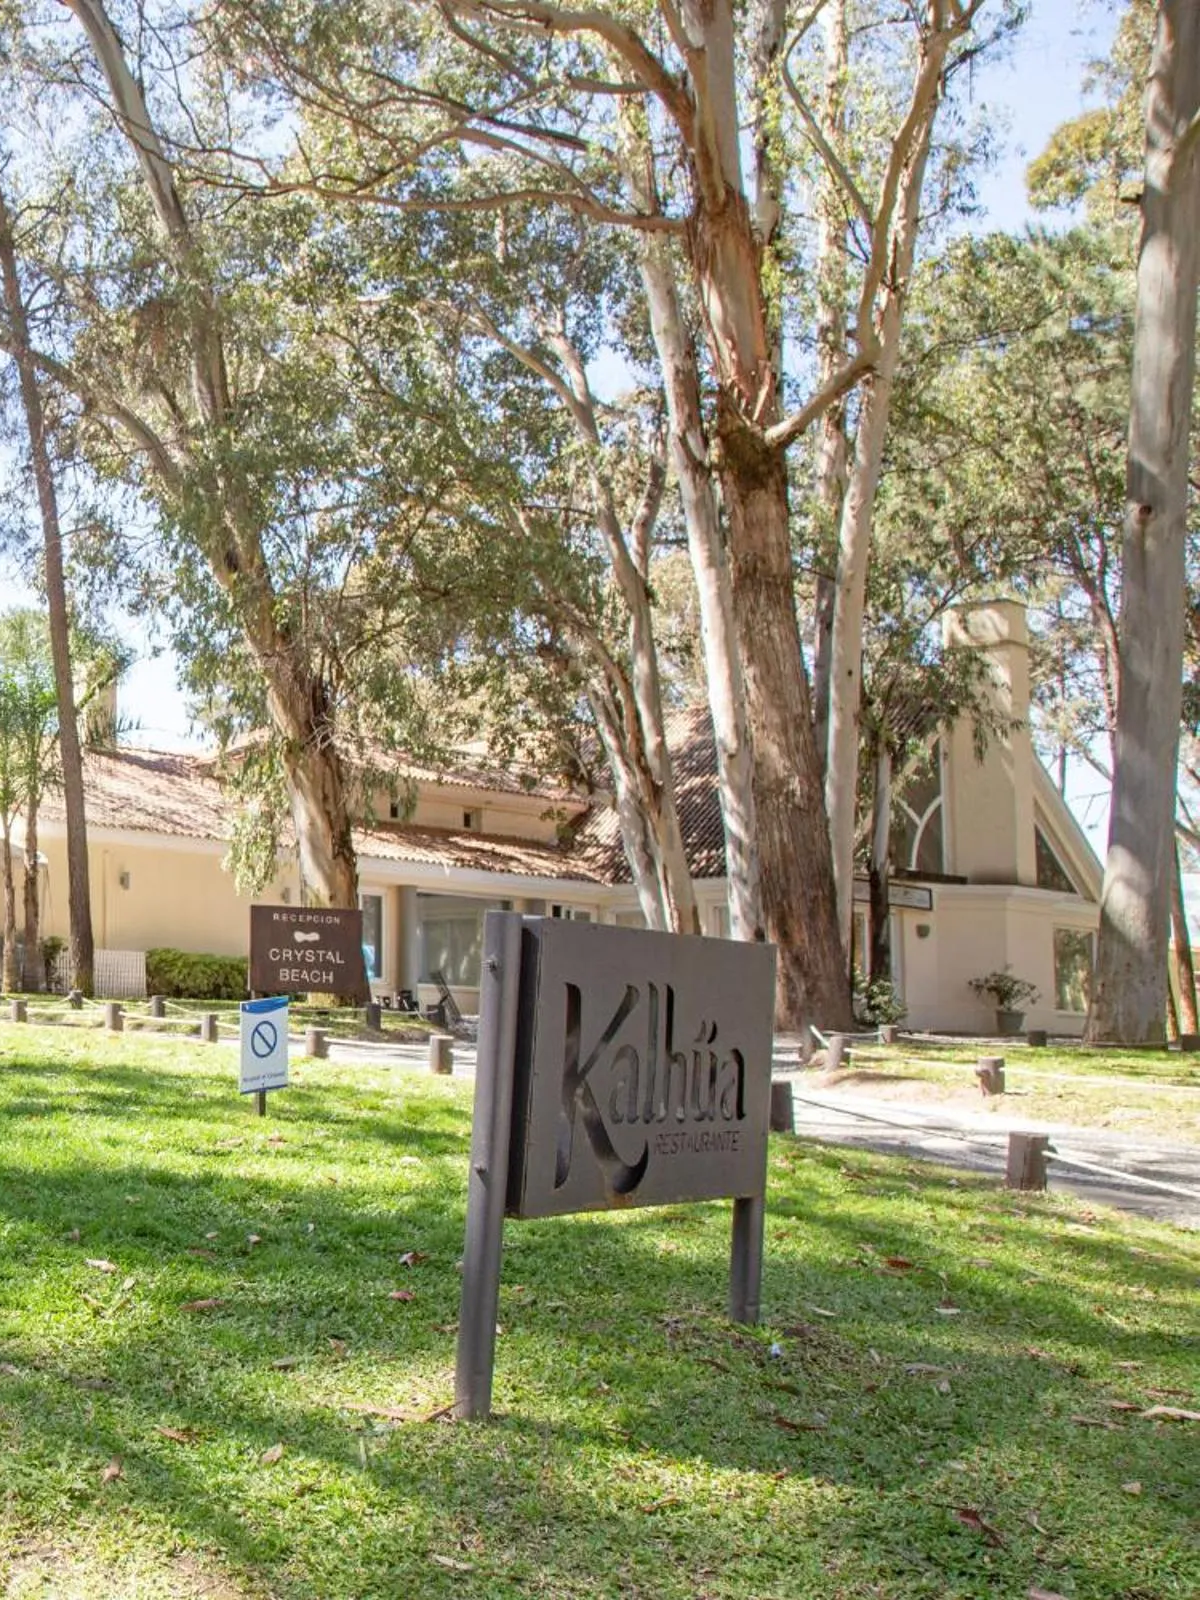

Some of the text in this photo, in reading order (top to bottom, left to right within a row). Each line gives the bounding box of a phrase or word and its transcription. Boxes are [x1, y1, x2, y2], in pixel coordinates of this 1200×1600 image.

[268, 947, 345, 964] CRYSTAL
[279, 967, 334, 984] BEACH
[654, 1130, 742, 1155] RESTAURANTE
